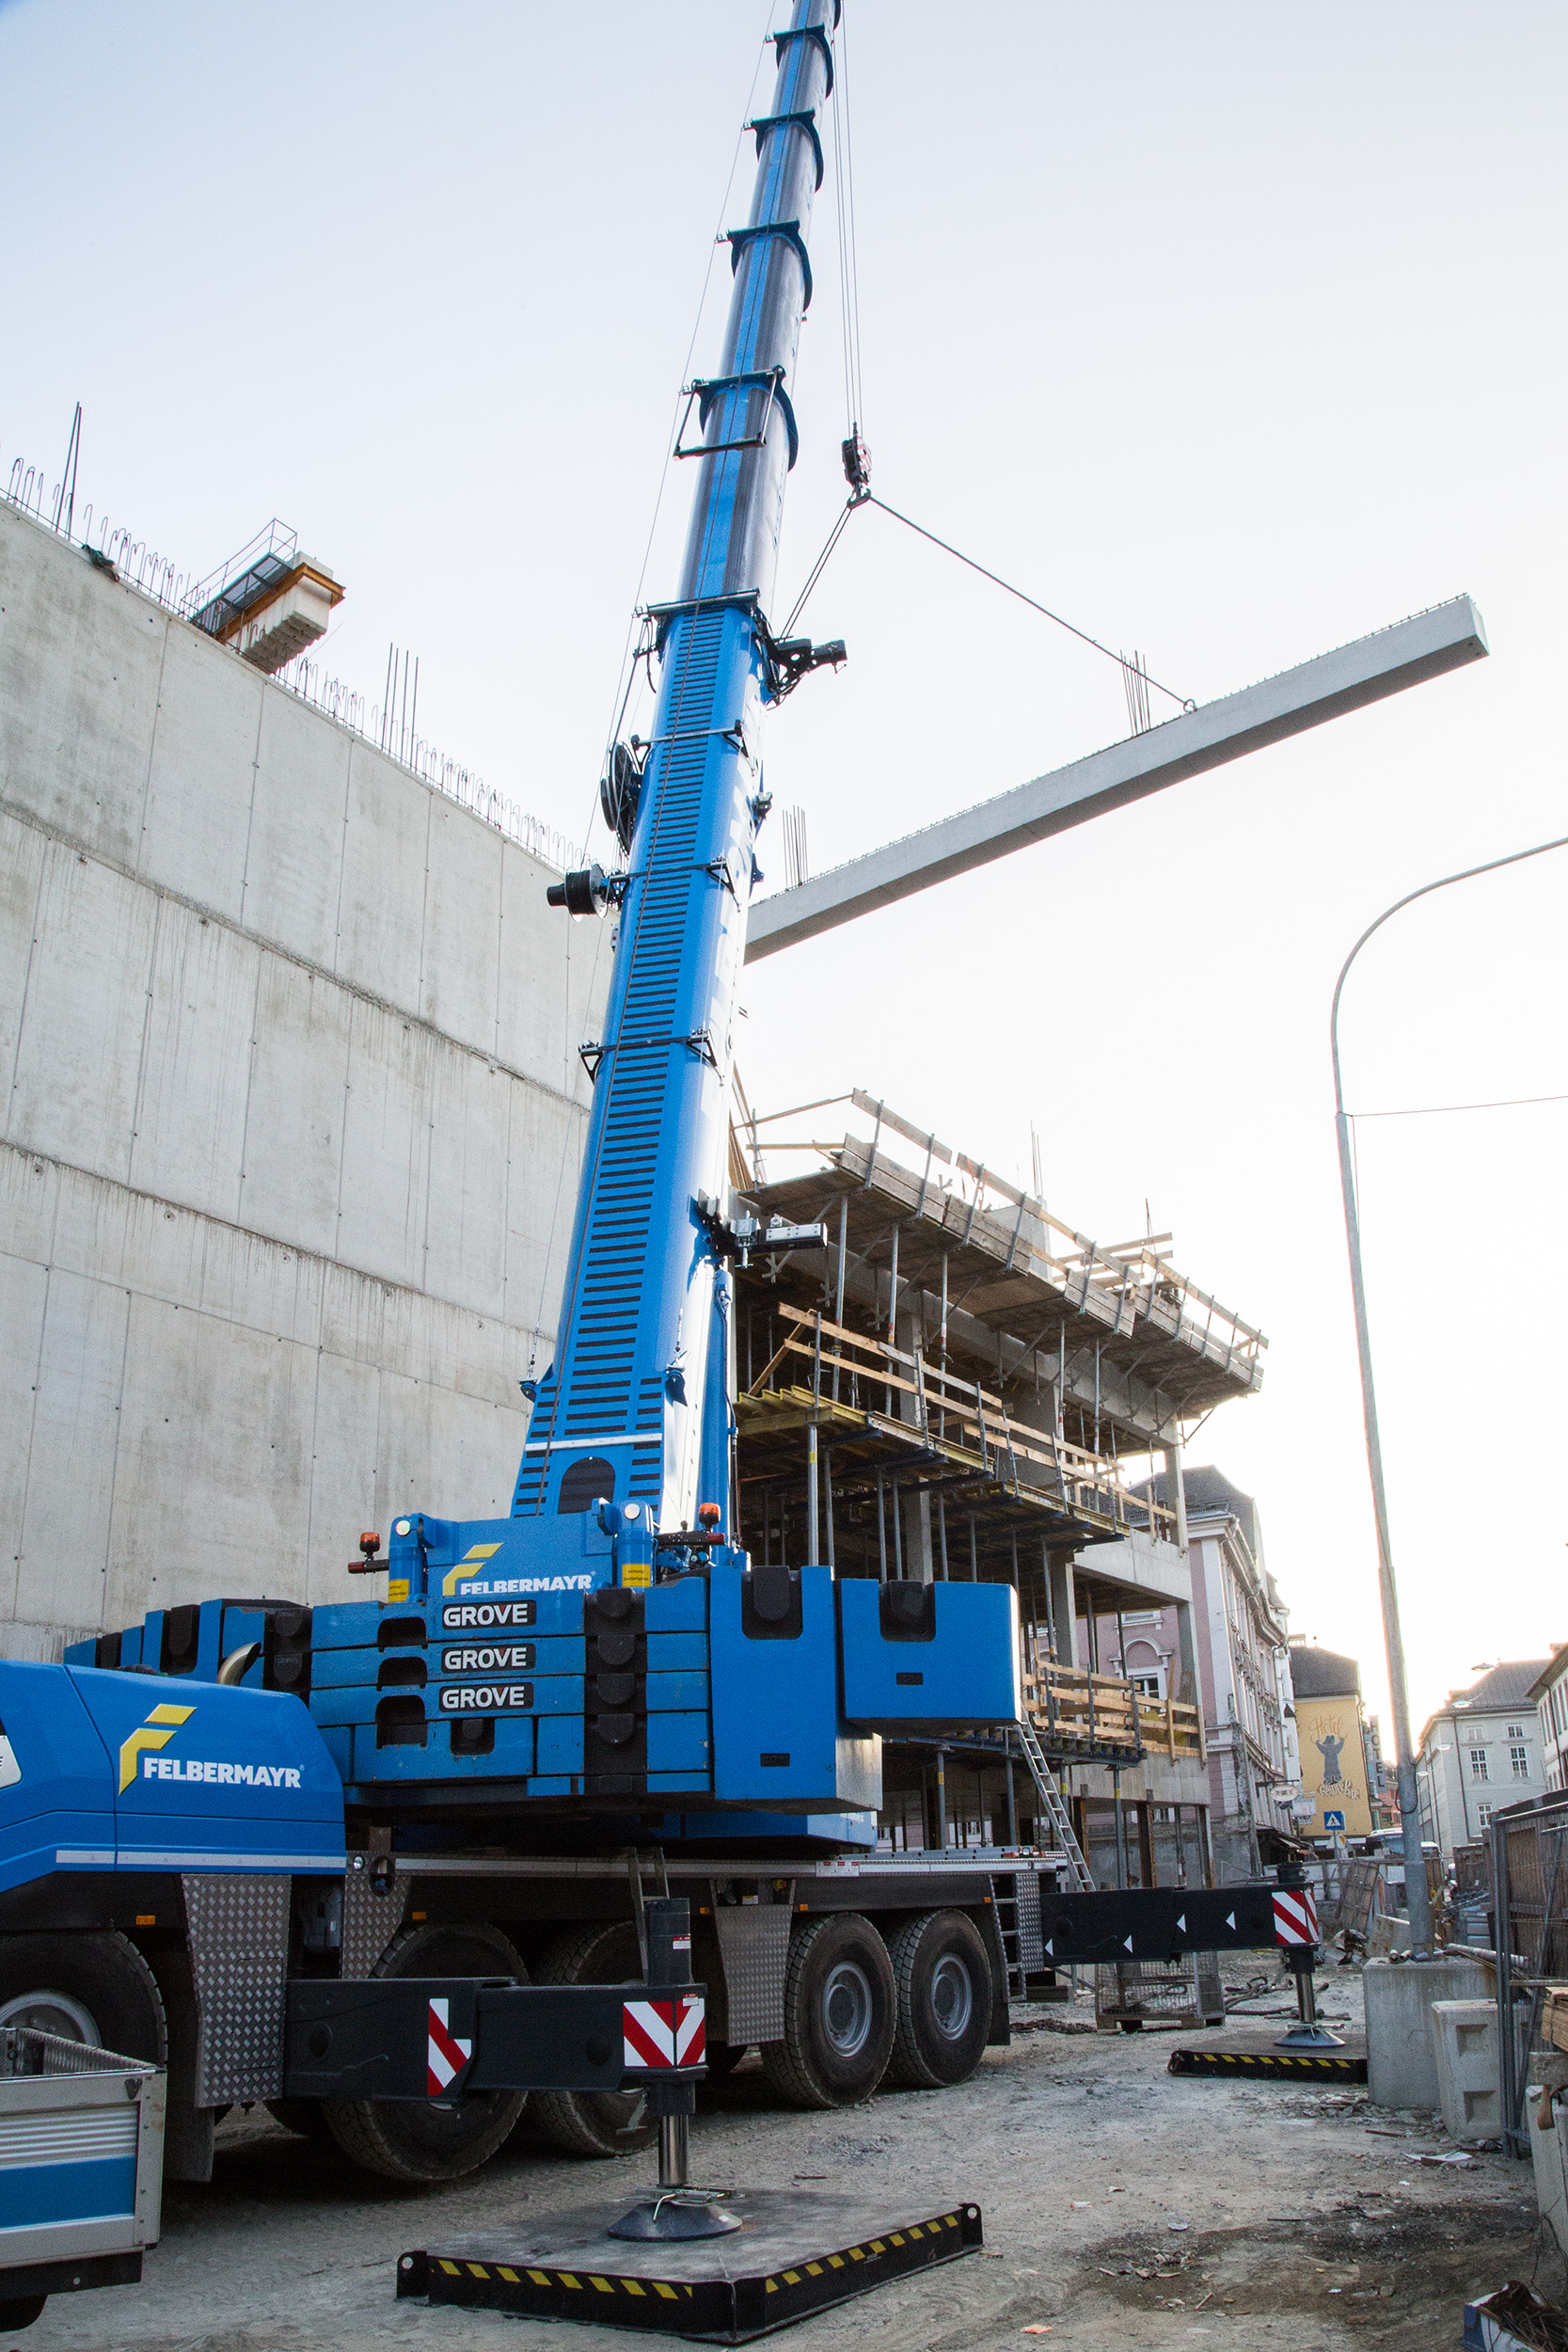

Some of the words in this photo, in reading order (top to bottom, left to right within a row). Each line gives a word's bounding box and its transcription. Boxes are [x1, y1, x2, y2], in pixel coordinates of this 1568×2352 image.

[460, 1574, 593, 1596] FELBERMAYR
[443, 1603, 528, 1627] GROVE
[444, 1646, 527, 1670] GROVE
[442, 1685, 525, 1709] GROVE
[1308, 1714, 1343, 1739] Hotel
[1370, 1721, 1385, 1788] HOTEL
[143, 1756, 302, 1788] FELBERMAYR
